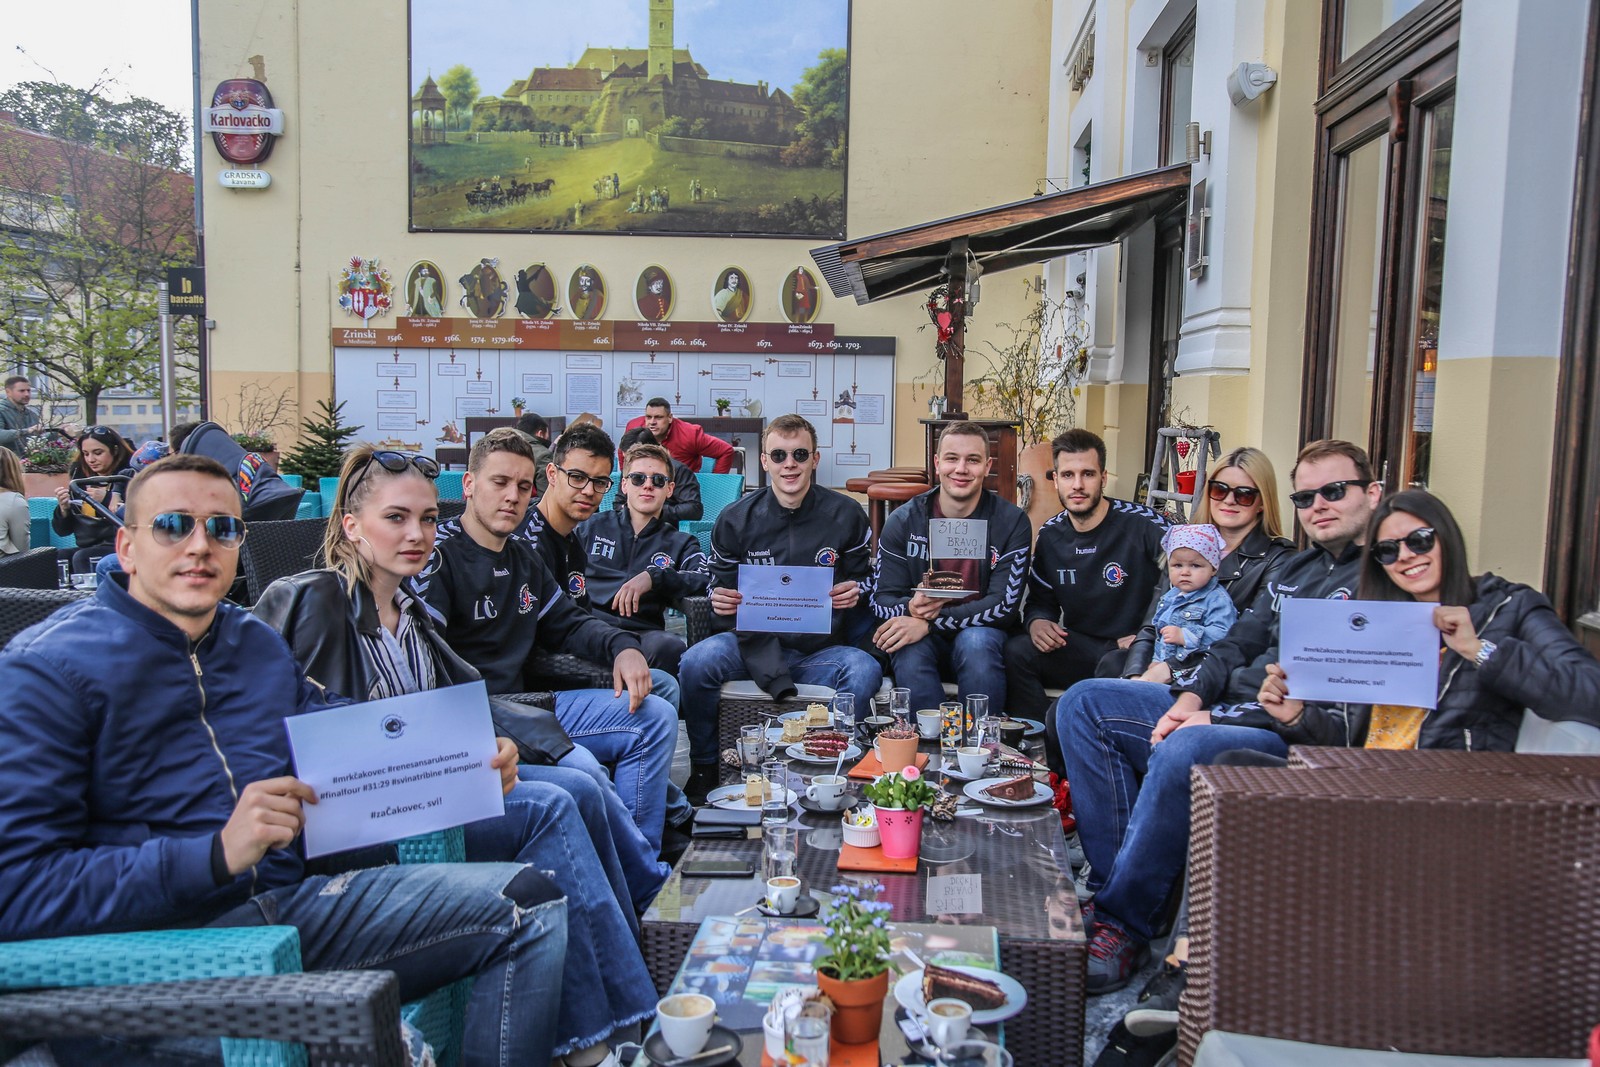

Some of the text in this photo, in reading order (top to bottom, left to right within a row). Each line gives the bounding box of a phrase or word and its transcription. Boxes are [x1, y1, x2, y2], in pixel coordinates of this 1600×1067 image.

[210, 113, 271, 127] Karlovačko
[343, 329, 376, 338] Zrinski
[387, 333, 403, 343] 1546.
[444, 334, 461, 343] 1566.
[644, 338, 660, 346] 1651.
[690, 338, 707, 347] 1664.
[757, 340, 773, 348] 1671.
[808, 340, 824, 349] 1673.
[826, 340, 842, 349] 1691.
[594, 535, 616, 545] hummel
[947, 536, 978, 546] BRAVO
[590, 542, 616, 560] EH
[1056, 569, 1076, 584] TT
[474, 595, 498, 620] LČ
[1328, 676, 1371, 686] #zaČakovec,
[332, 750, 469, 784] #mrkčakovec #renesansarukometa
[320, 760, 483, 800] #finalfour #31:29 #svinatribine #šampioni
[370, 797, 442, 820] #zaČakovec, svi!
